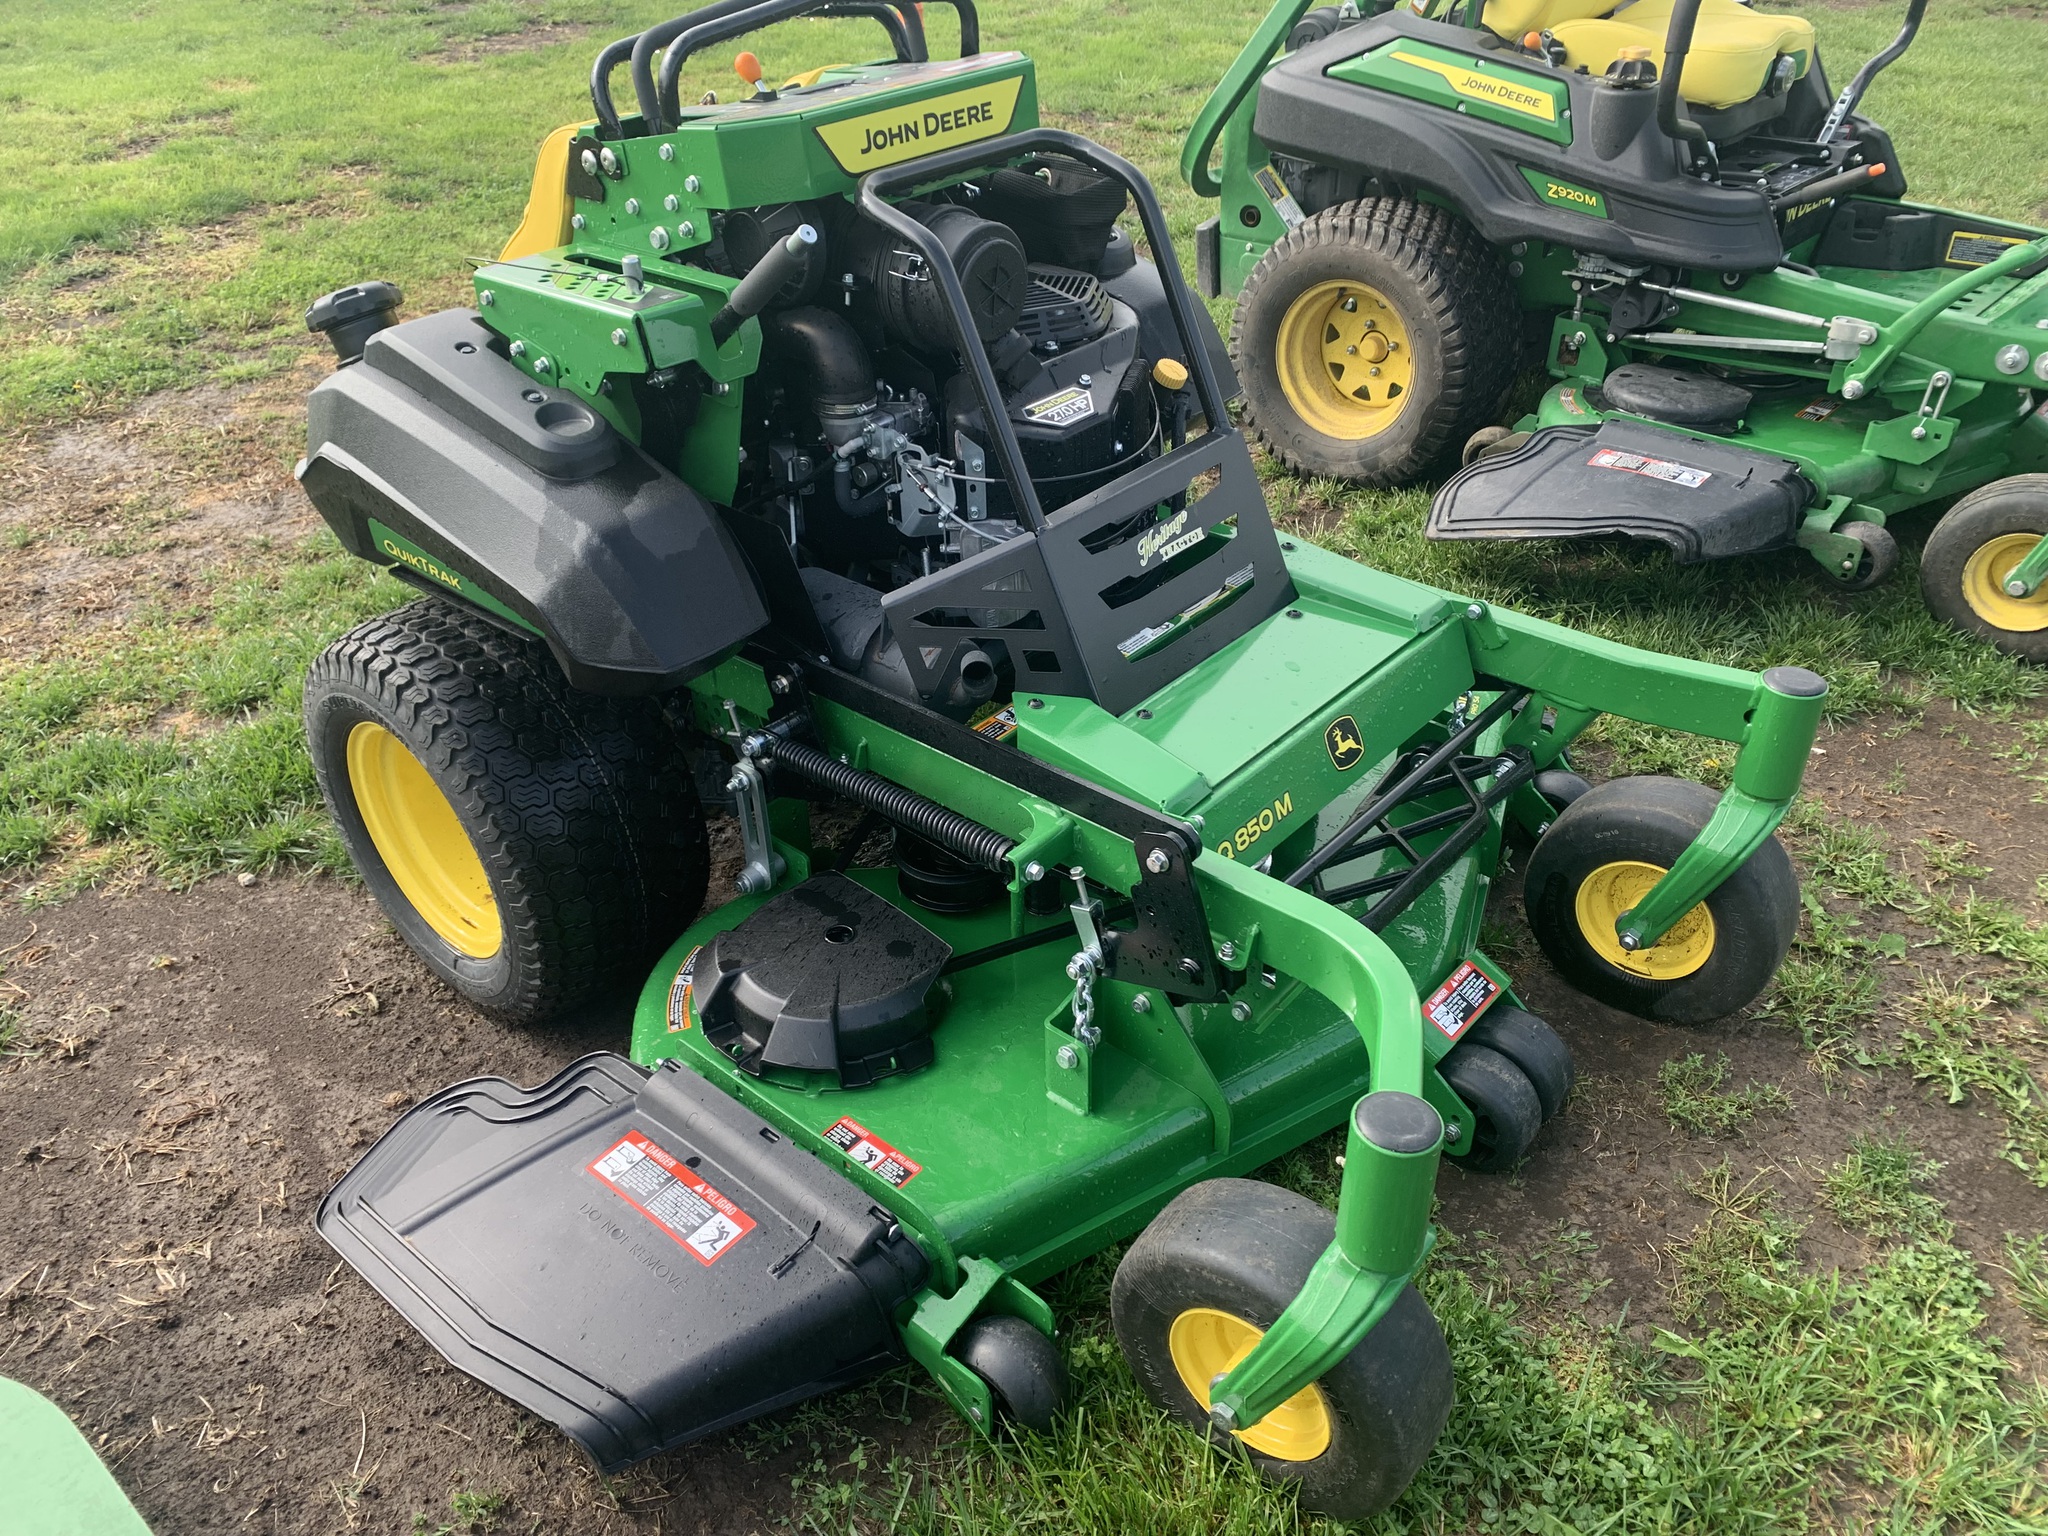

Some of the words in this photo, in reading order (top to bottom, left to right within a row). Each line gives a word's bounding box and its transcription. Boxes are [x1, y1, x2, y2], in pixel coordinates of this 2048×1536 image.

[1461, 76, 1497, 97] JOHN
[1497, 85, 1542, 108] DEERE
[860, 120, 920, 155] JOHN
[922, 101, 993, 137] DEERE
[1069, 398, 1088, 412] HP
[1137, 510, 1188, 567] Heritage
[645, 1145, 677, 1169] DANGER
[702, 1188, 738, 1216] PELIGRO
[579, 1203, 602, 1222] DO
[600, 1219, 631, 1245] NOT
[628, 1243, 688, 1294] REMOVE
